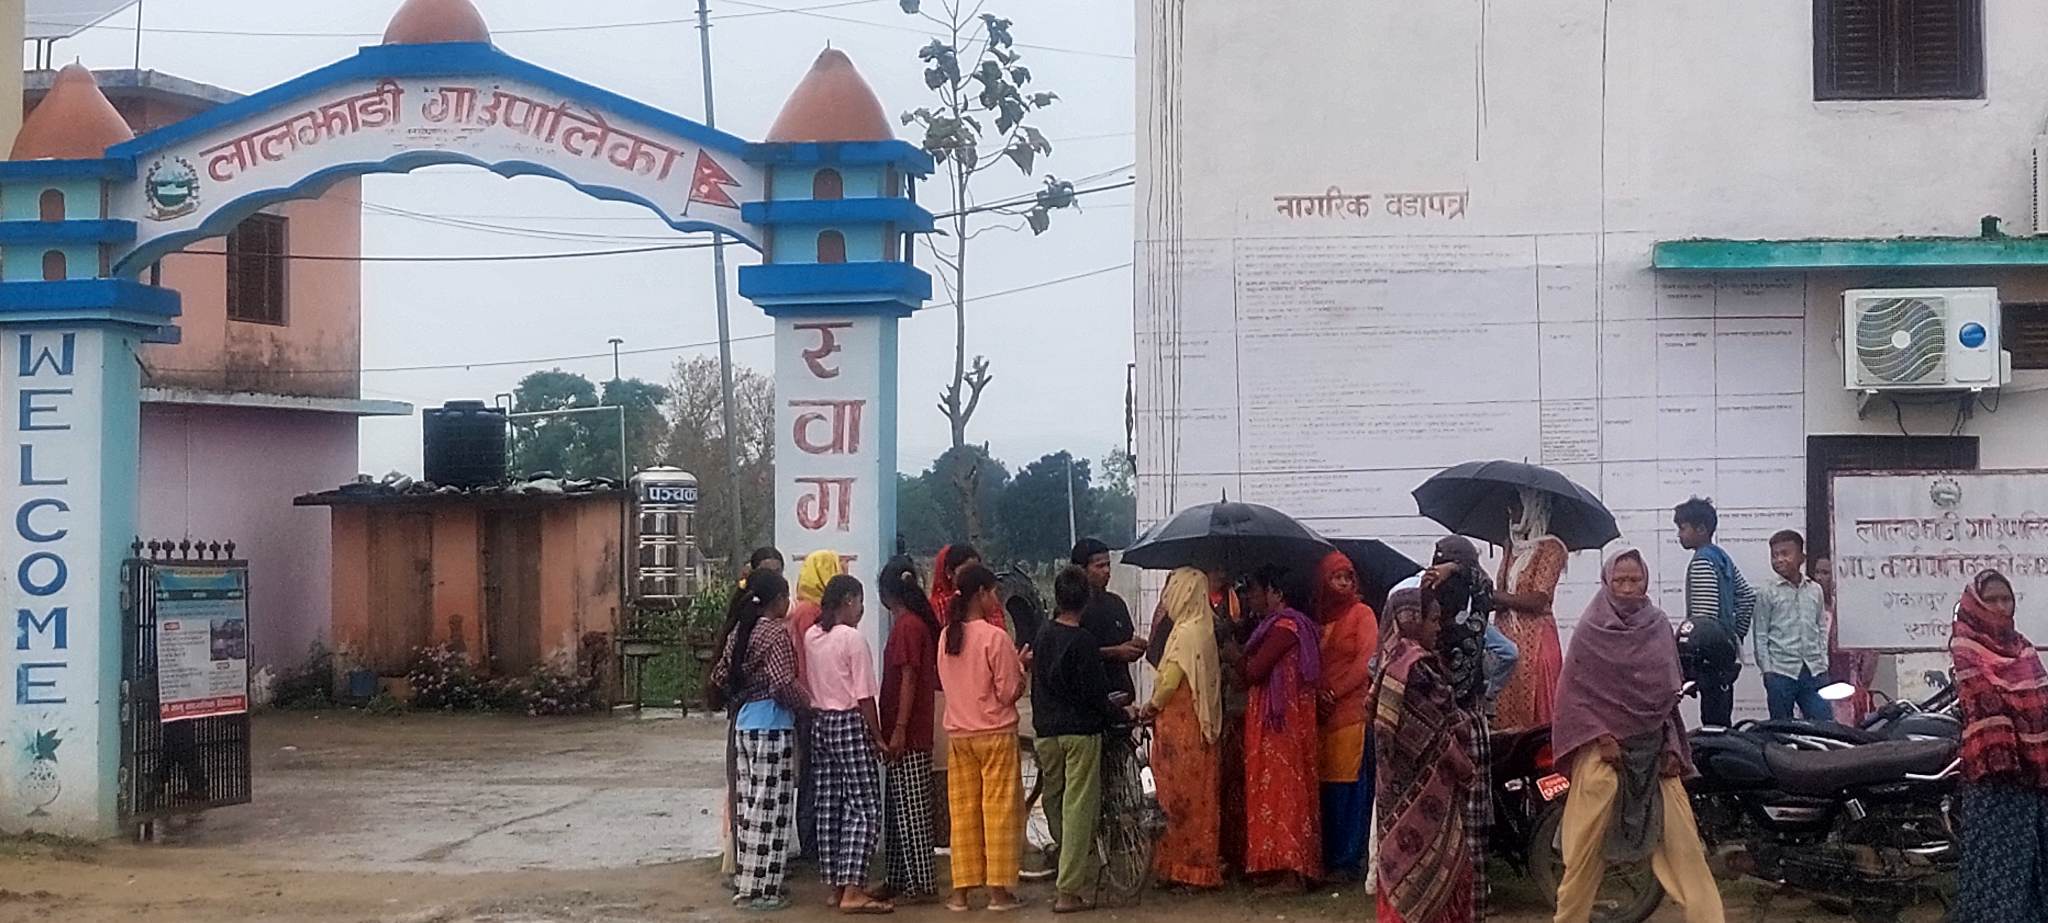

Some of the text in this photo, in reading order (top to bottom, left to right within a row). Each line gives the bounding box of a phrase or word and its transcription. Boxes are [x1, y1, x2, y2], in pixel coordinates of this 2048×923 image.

[1273, 185, 1371, 220] नागरिक
[15, 332, 76, 706] WELCOME
[788, 321, 867, 578] स्वाग
